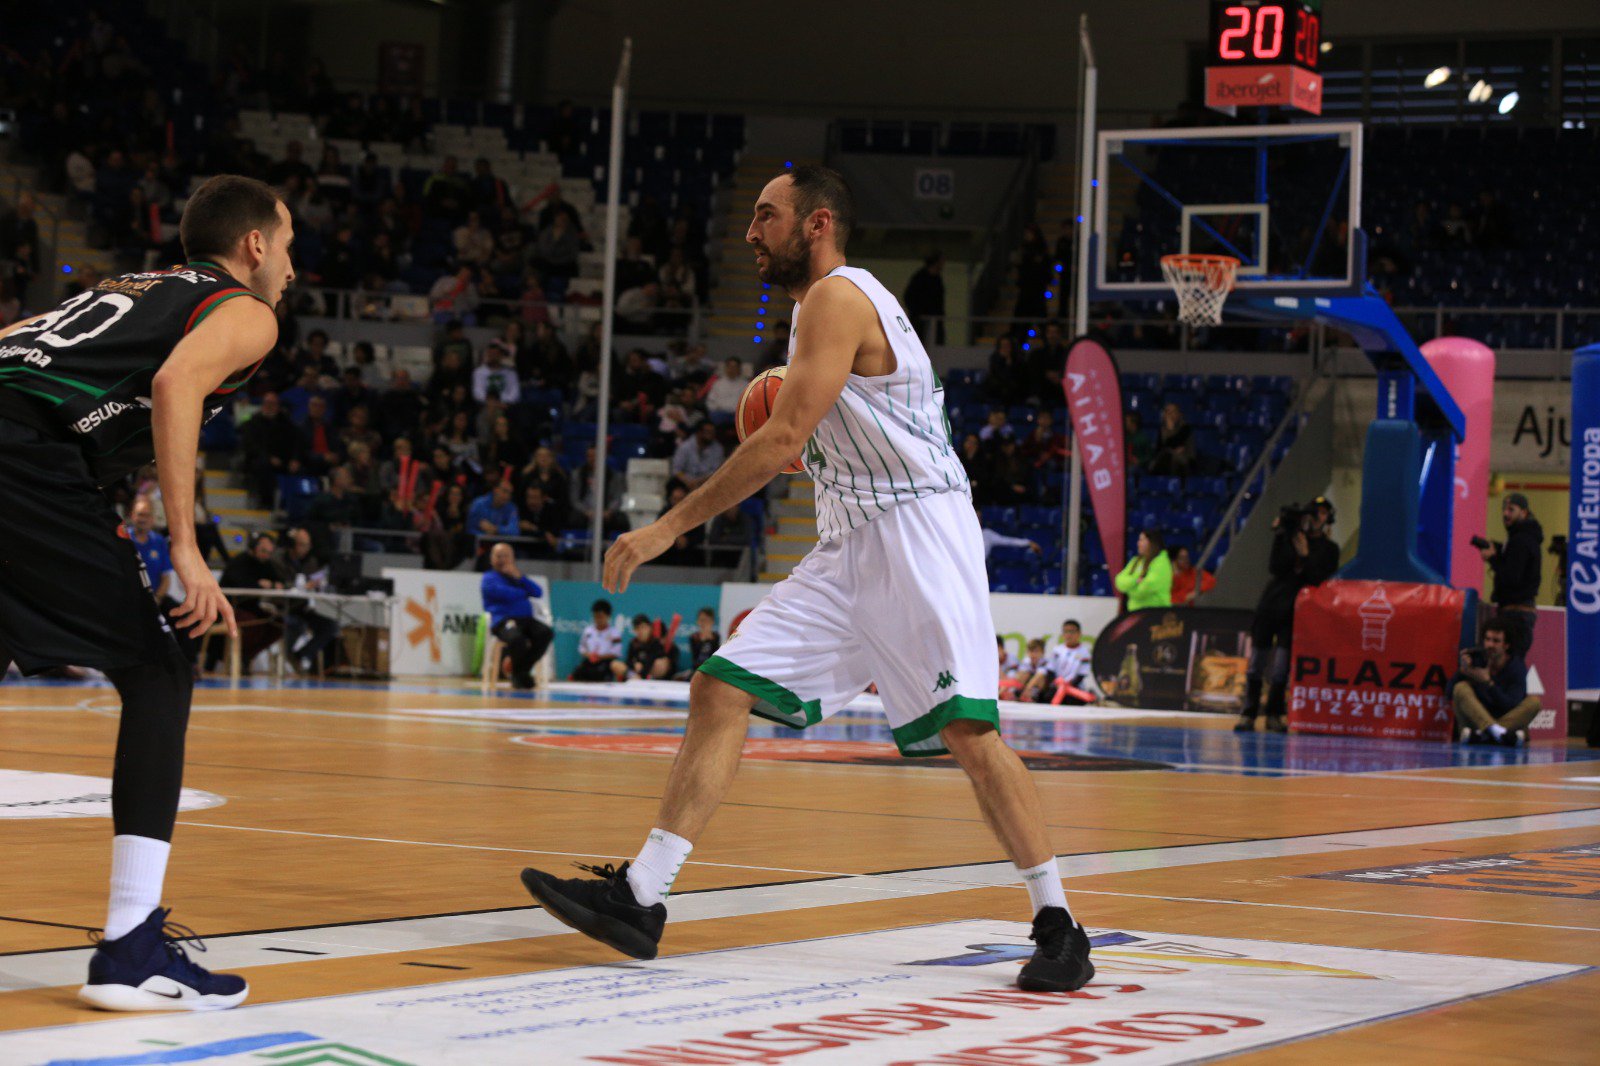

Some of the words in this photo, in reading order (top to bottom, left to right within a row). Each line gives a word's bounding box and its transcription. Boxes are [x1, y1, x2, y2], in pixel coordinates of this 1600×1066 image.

[1219, 6, 1284, 59] 20
[1295, 10, 1318, 67] 20
[918, 173, 951, 195] 08
[1296, 656, 1449, 690] PLAZA
[1292, 700, 1448, 721] PIZZERIA
